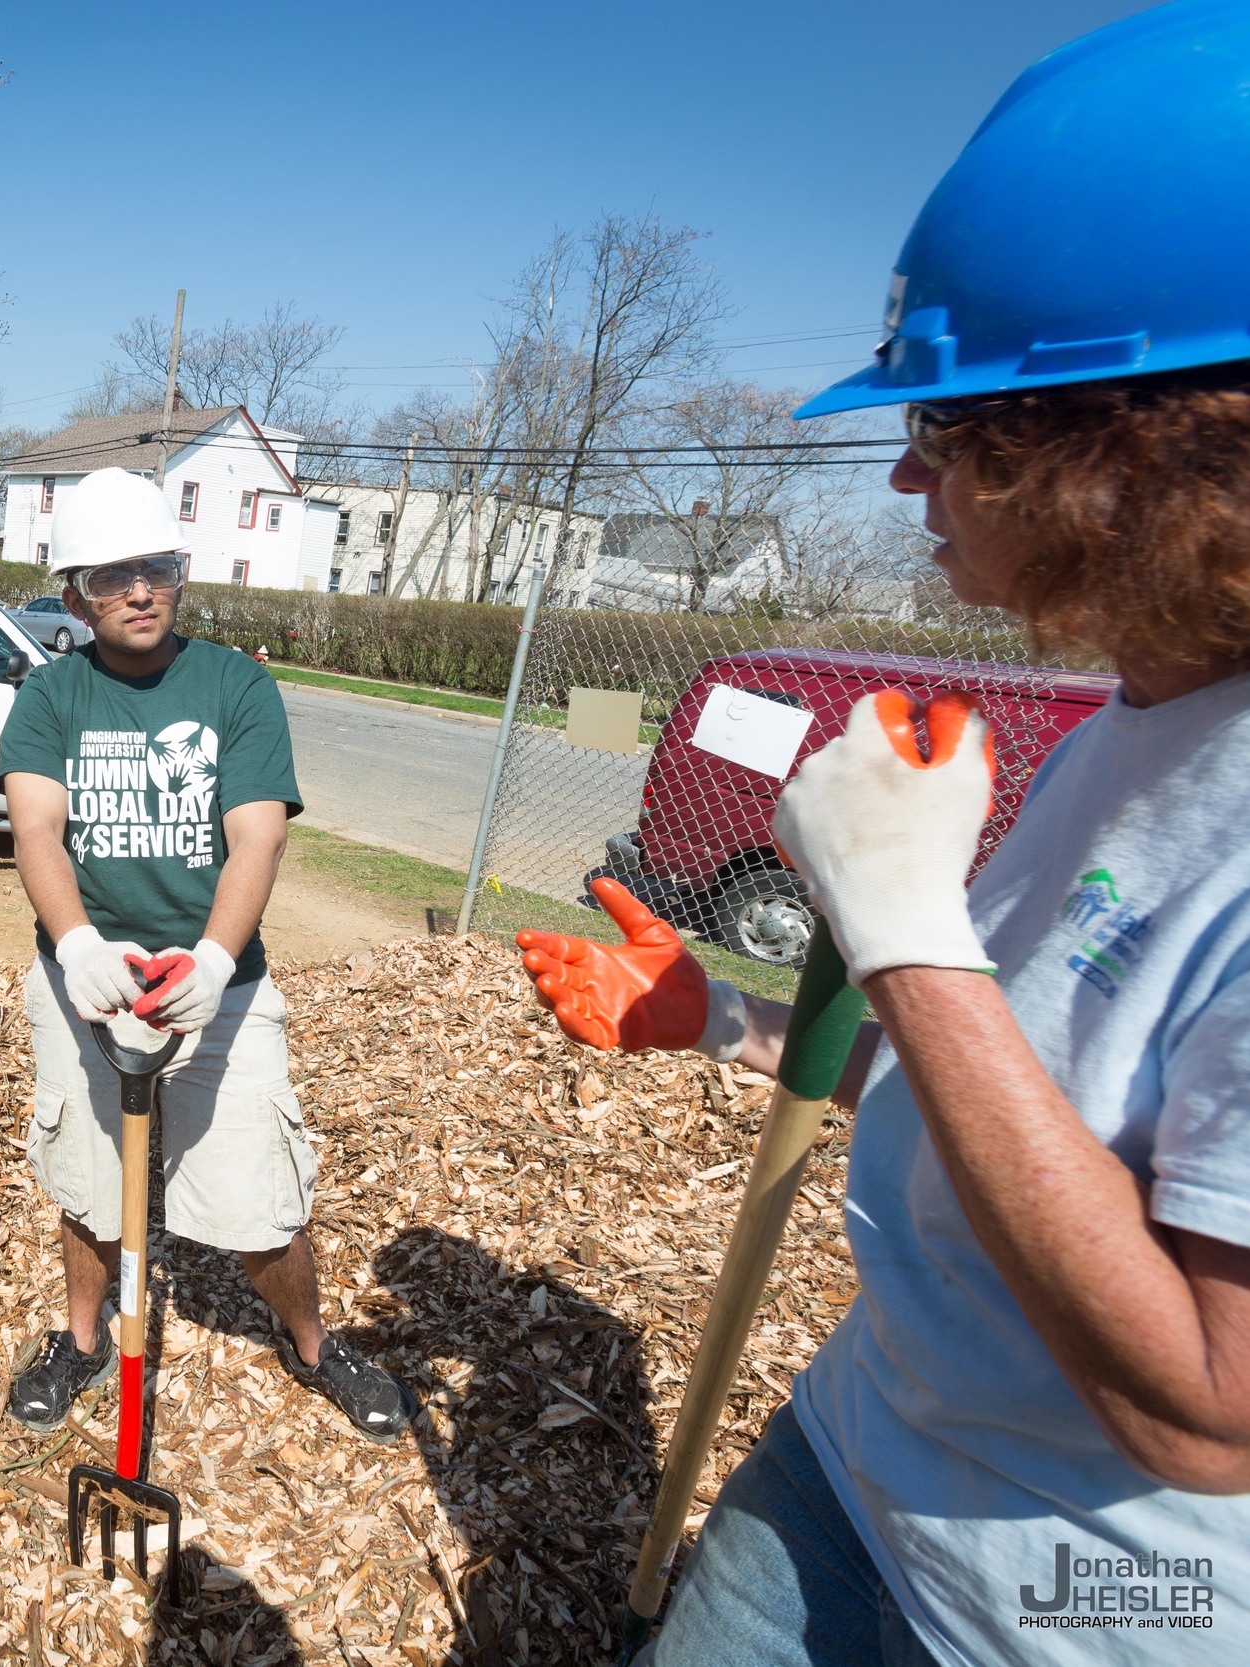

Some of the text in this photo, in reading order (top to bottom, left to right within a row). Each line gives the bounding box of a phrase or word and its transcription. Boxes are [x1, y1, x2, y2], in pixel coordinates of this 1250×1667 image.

[80, 744, 147, 758] UNIVERSITY
[65, 758, 147, 791] LUMNI
[68, 790, 214, 824] LOBAL DAY
[71, 823, 213, 864] of SERVICE
[186, 853, 213, 869] 2015
